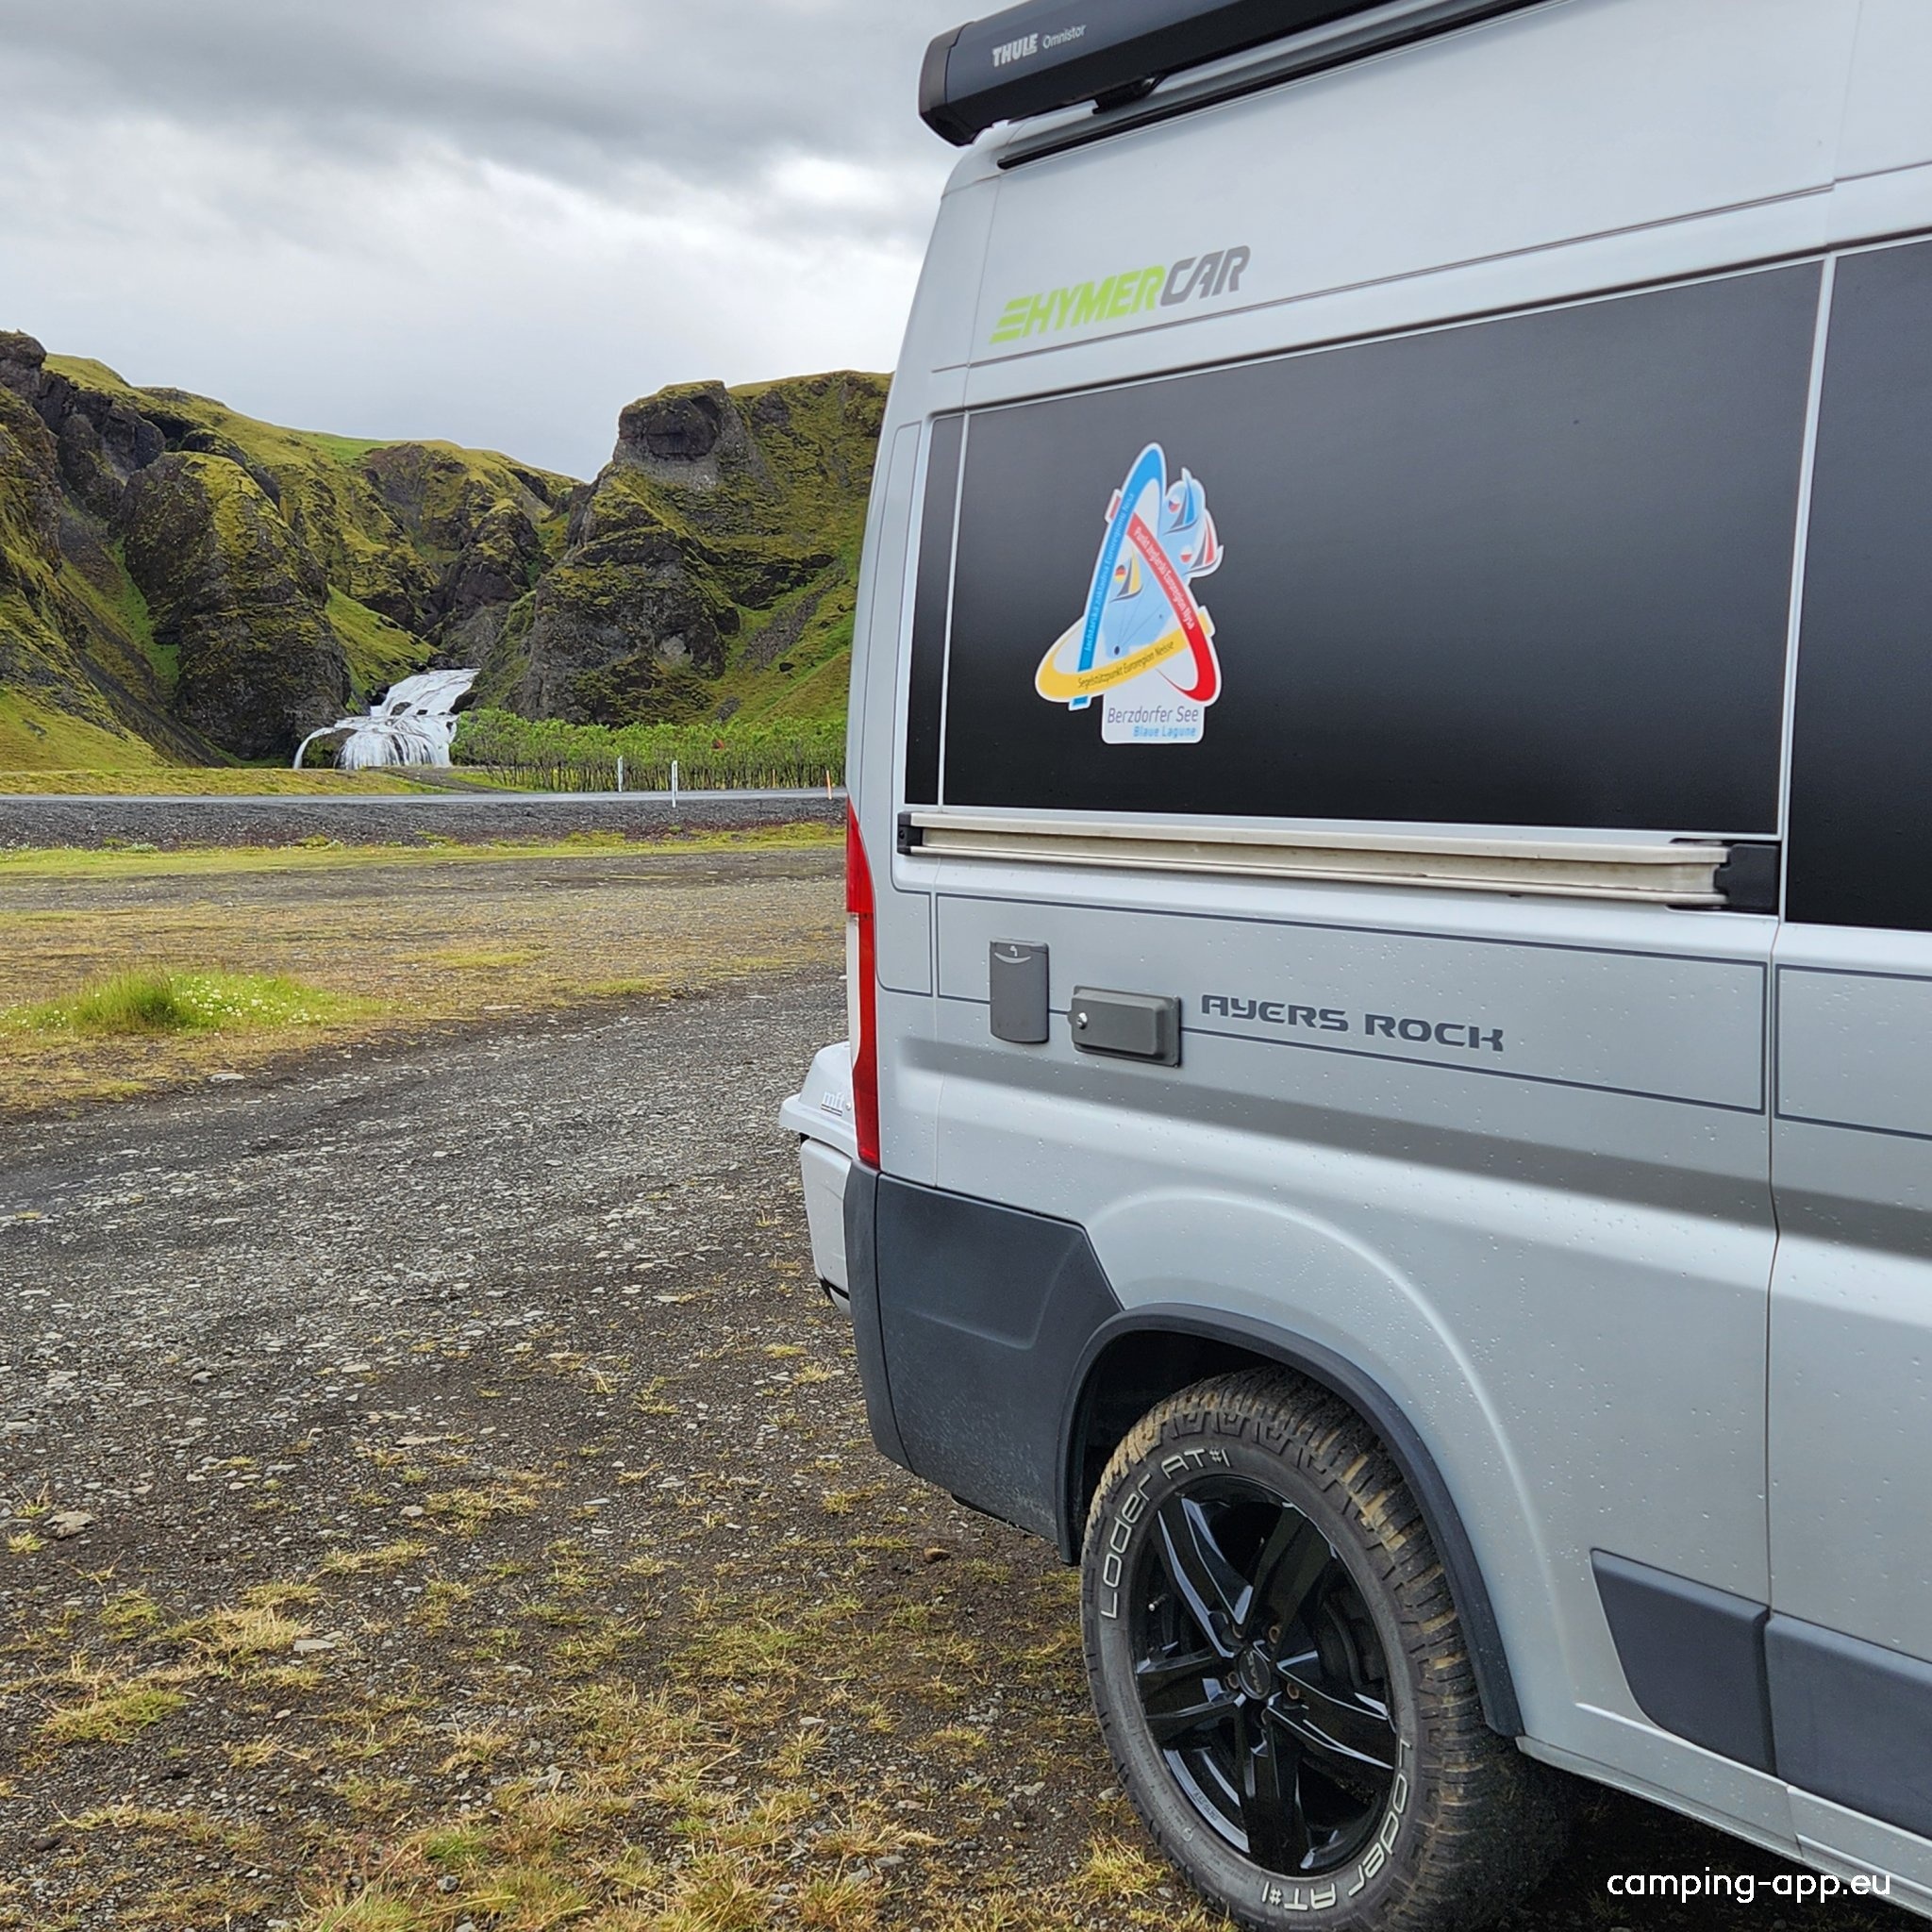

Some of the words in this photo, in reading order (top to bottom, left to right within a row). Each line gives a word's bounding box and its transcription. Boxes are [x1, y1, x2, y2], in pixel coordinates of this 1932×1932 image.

[992, 32, 1039, 68] THULE
[1042, 25, 1087, 49] Omnistor
[1124, 651, 1155, 676] Euroregion
[1108, 706, 1173, 724] Berzdorfer
[1175, 706, 1199, 723] See
[1133, 725, 1159, 738] Blaue
[1162, 725, 1196, 739] Lagune
[1202, 994, 1349, 1032] AYERS
[1365, 1013, 1504, 1052] ROCK
